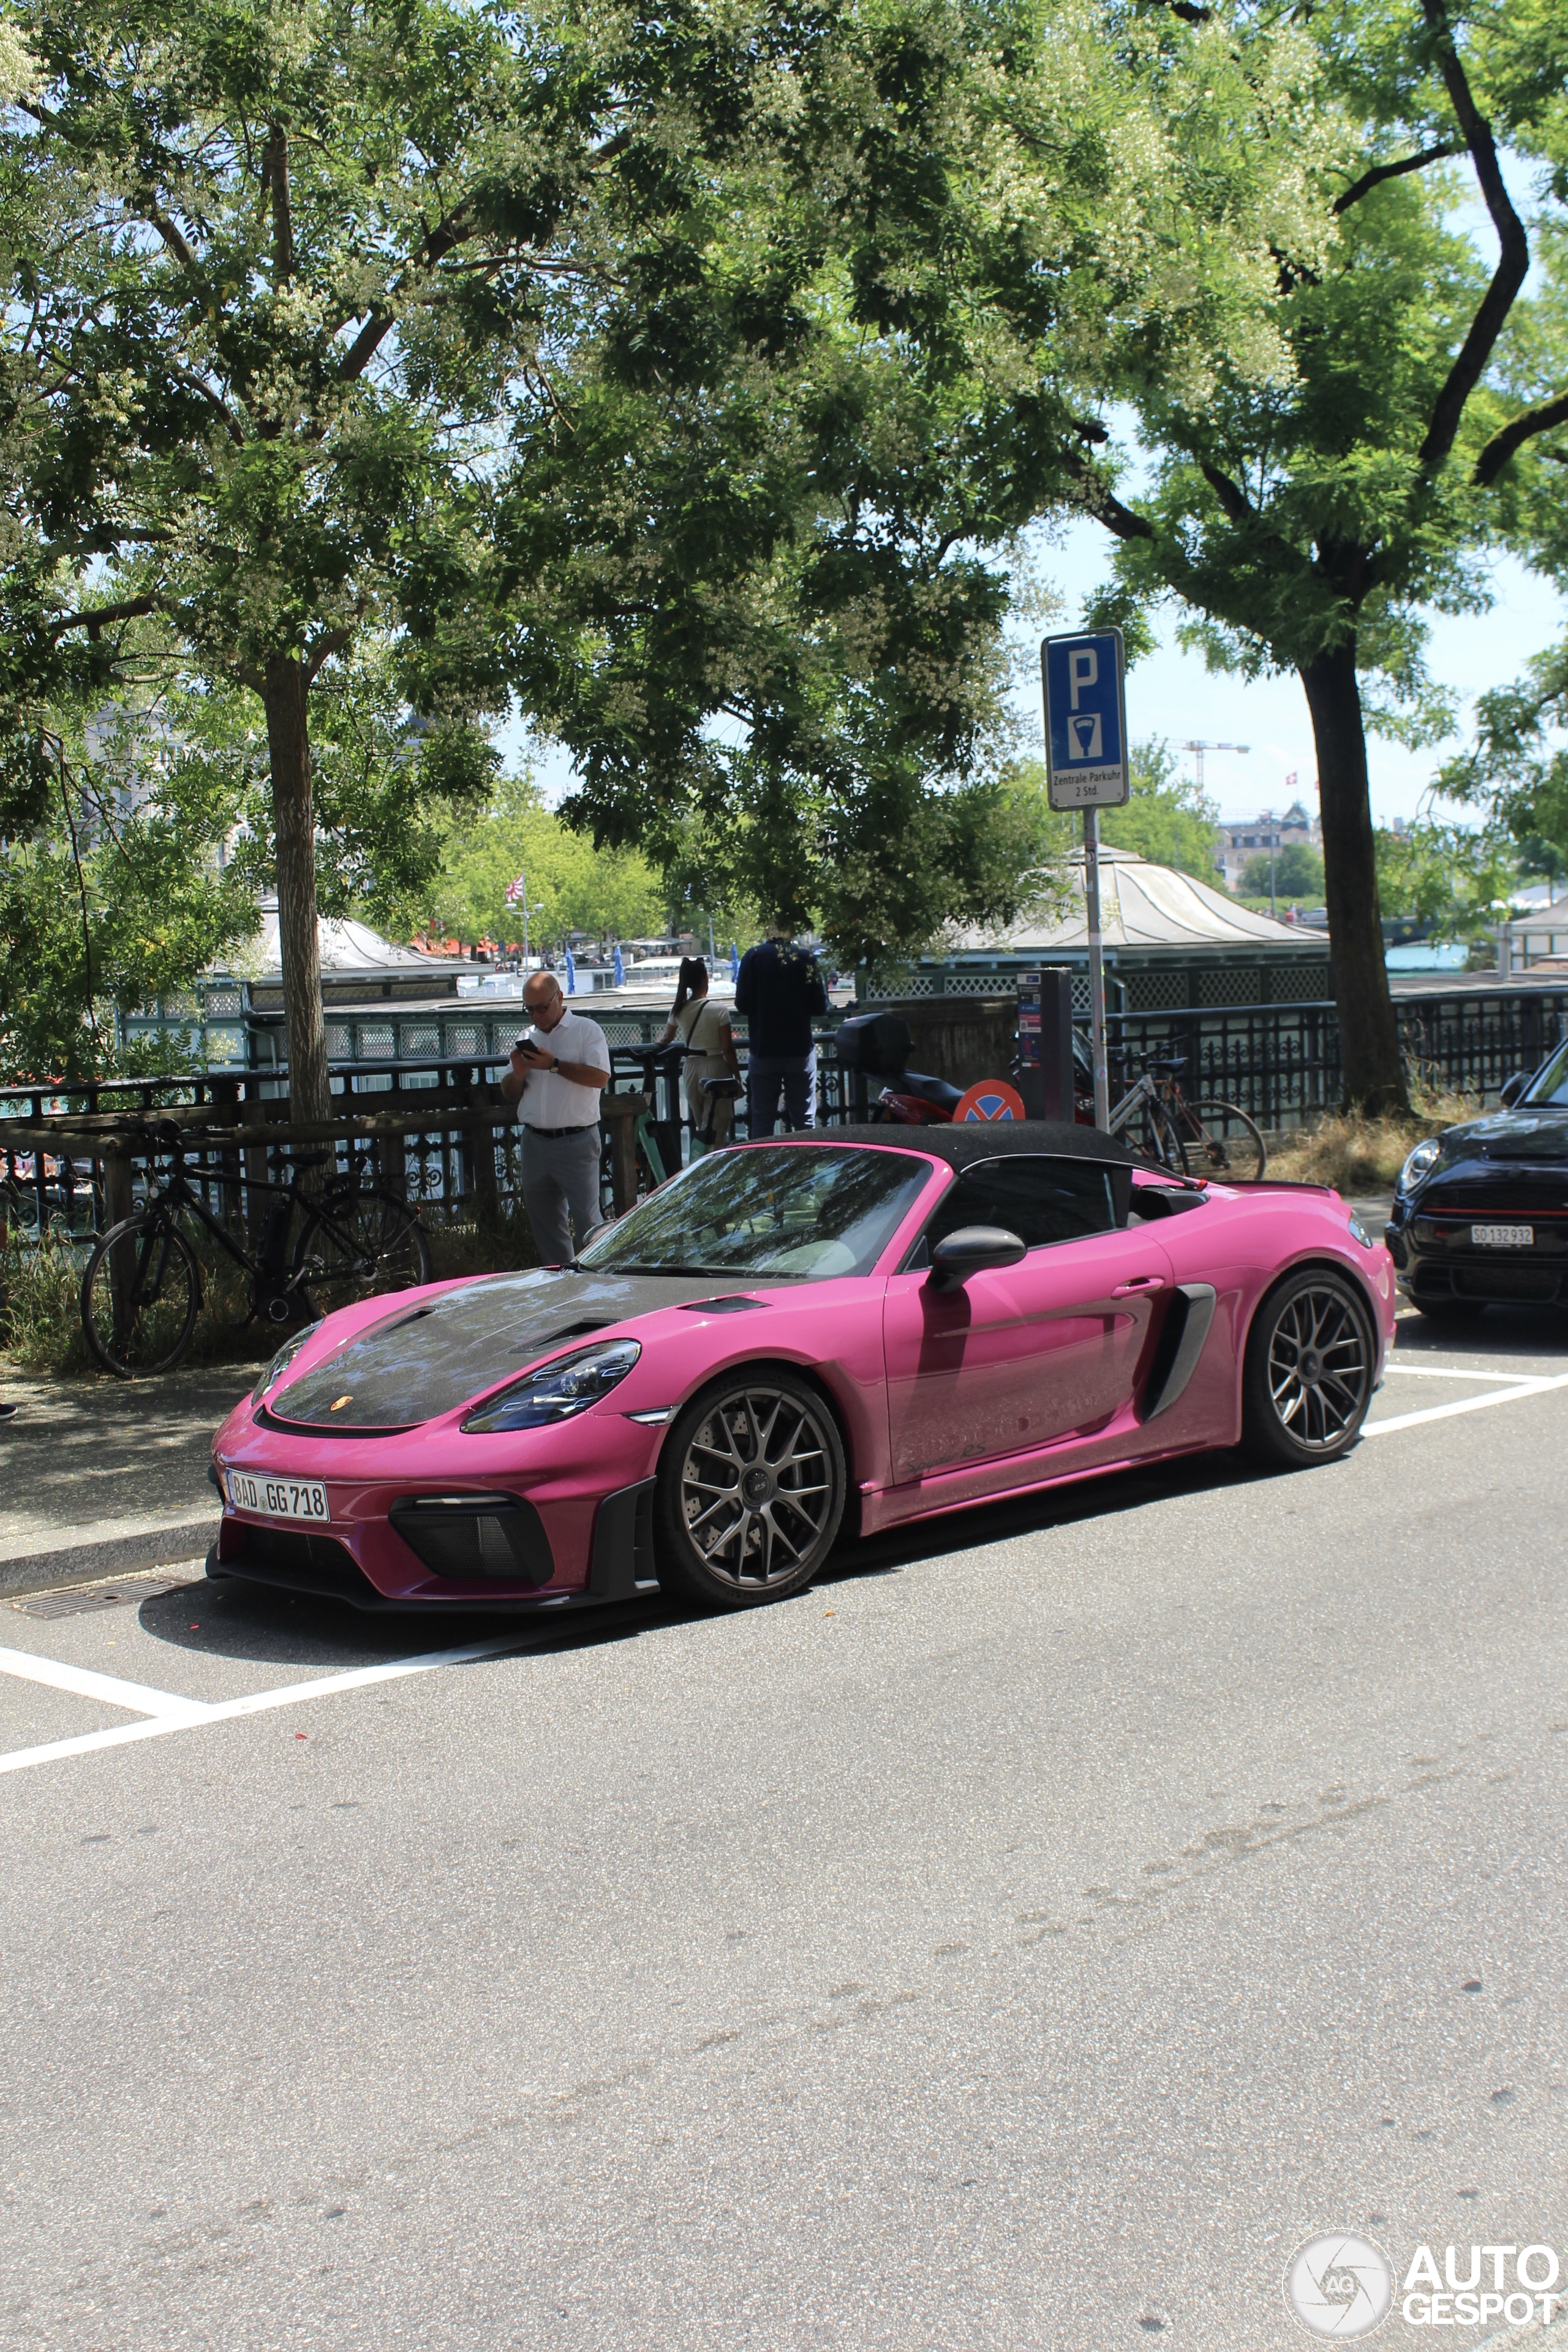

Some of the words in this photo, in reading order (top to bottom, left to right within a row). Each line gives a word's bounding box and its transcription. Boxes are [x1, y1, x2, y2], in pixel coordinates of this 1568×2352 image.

[1068, 648, 1098, 710] P
[1054, 774, 1087, 786] Zentrale
[1089, 771, 1121, 782] Parkuhr
[1076, 787, 1080, 796] 2
[1084, 786, 1099, 796] Std.
[900, 1452, 959, 1474] Spyder
[960, 1441, 987, 1458] RS
[233, 1476, 257, 1507] BAD
